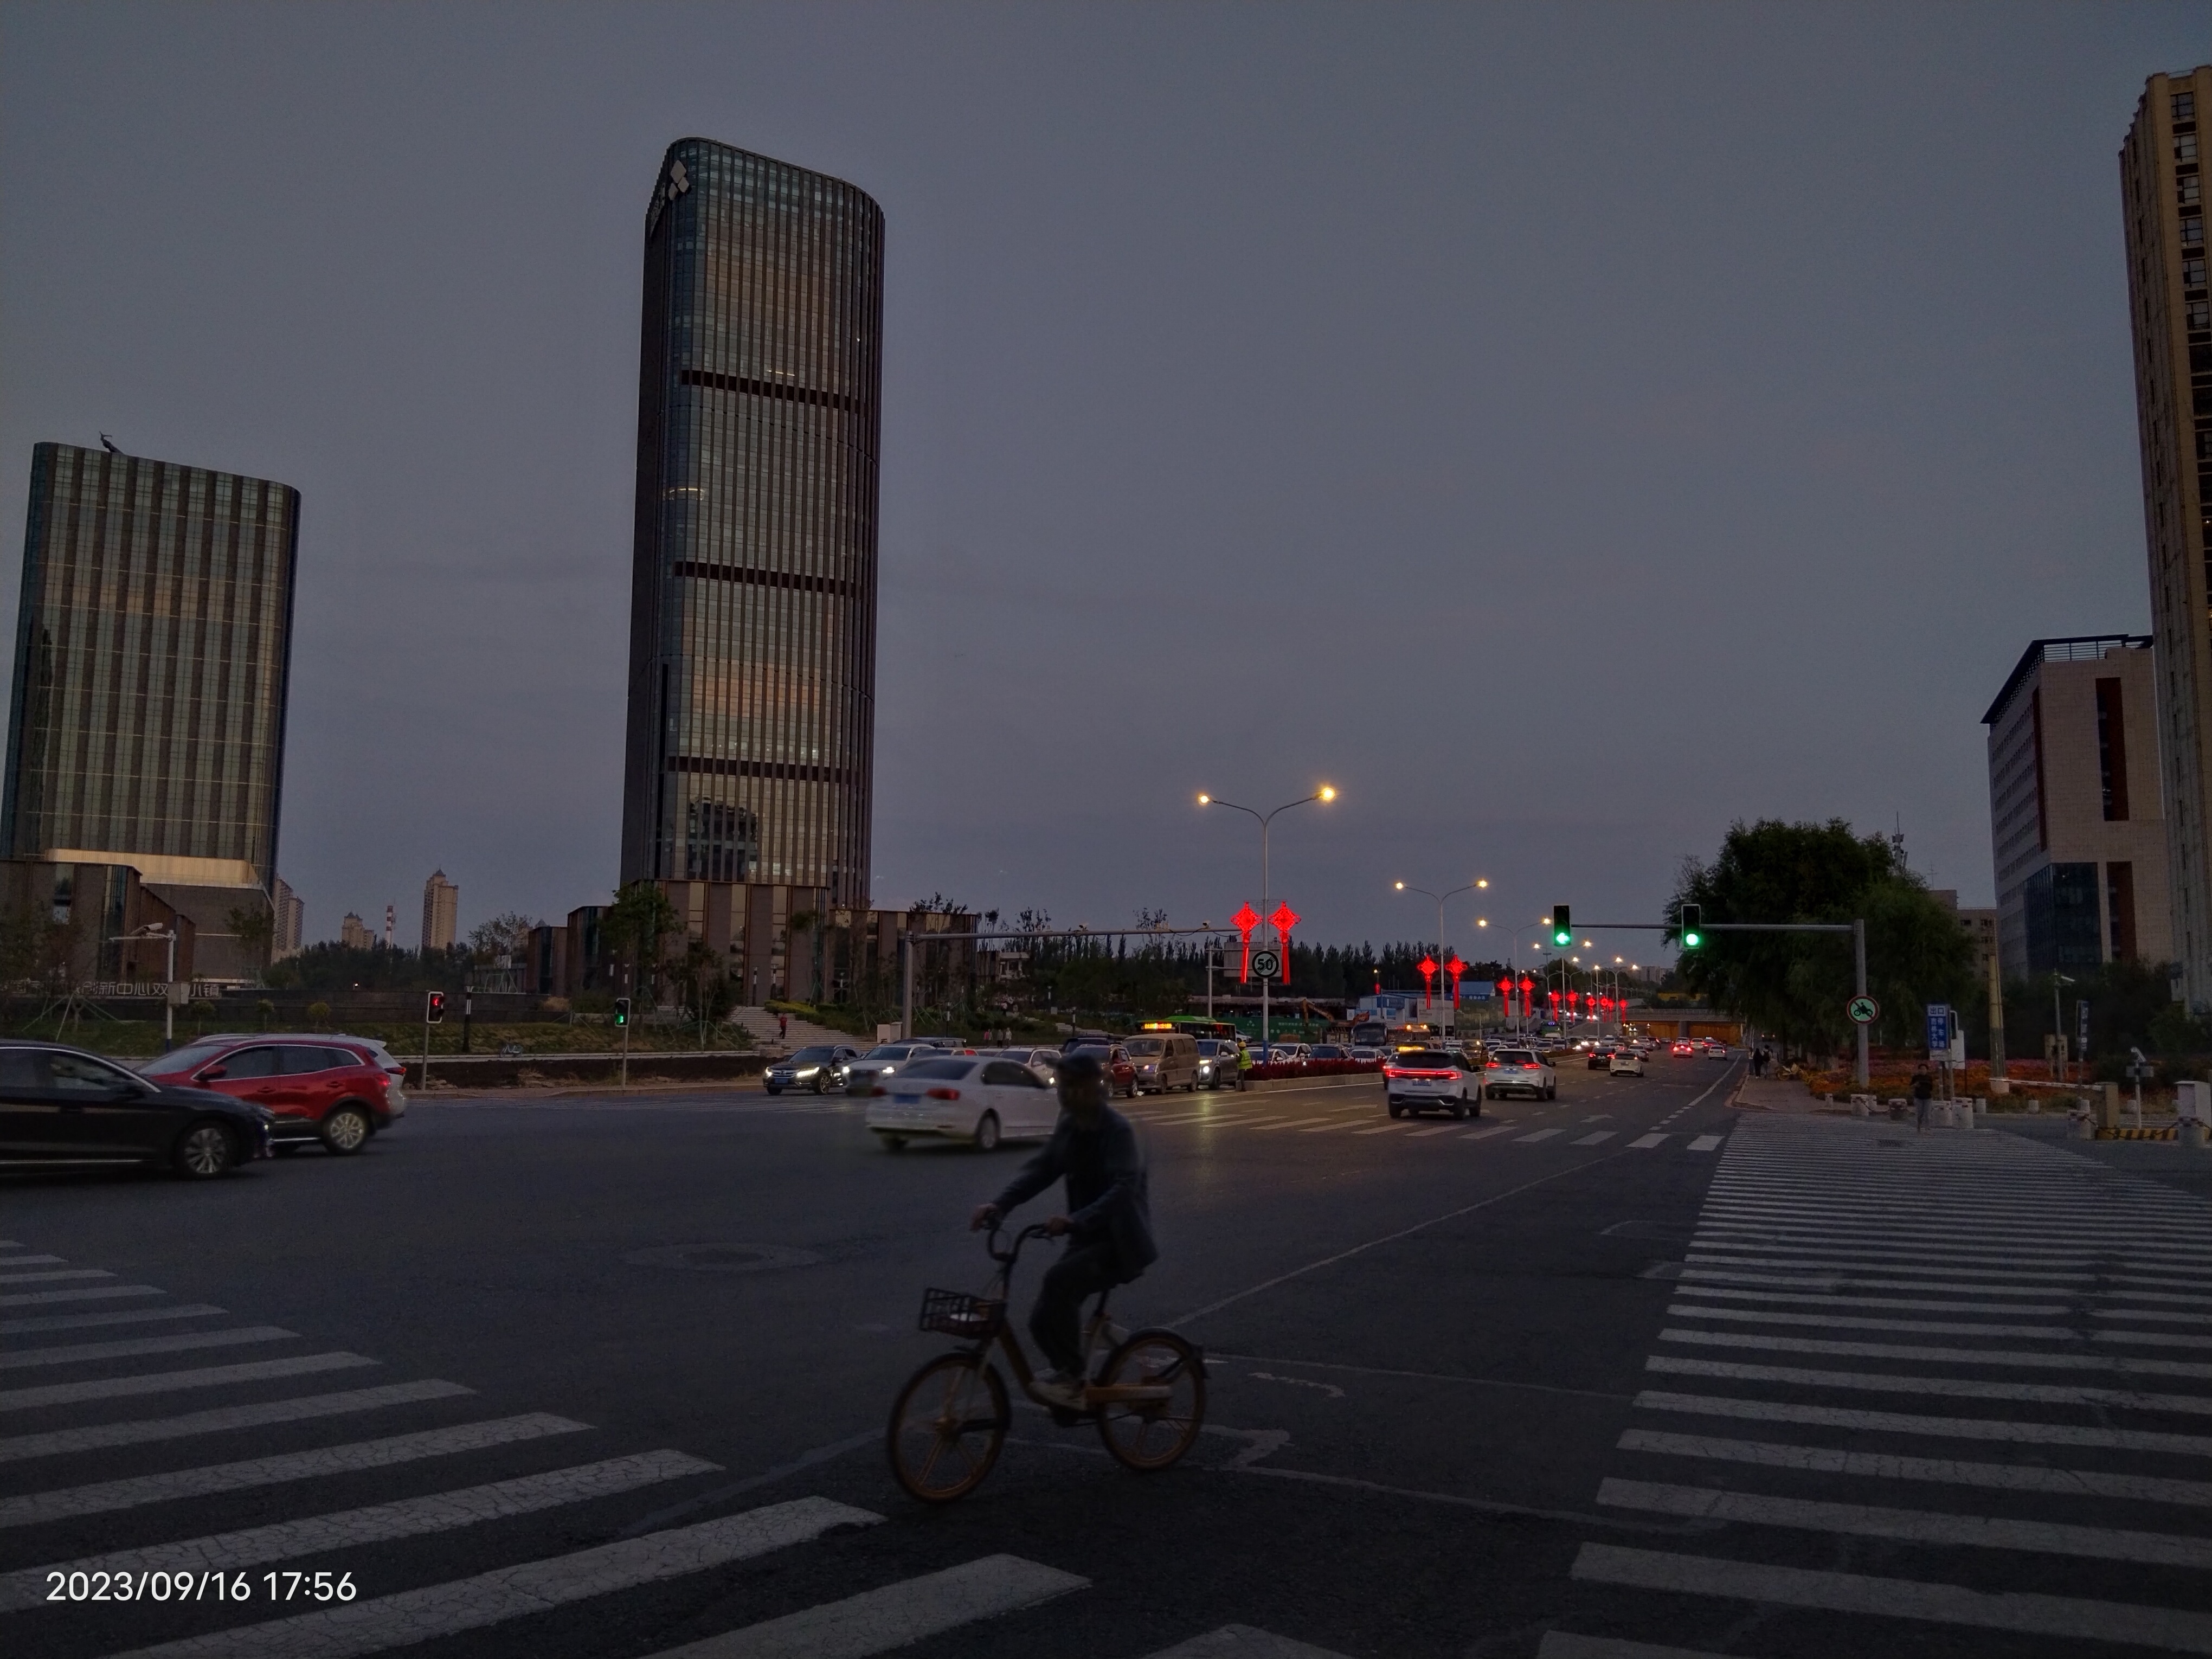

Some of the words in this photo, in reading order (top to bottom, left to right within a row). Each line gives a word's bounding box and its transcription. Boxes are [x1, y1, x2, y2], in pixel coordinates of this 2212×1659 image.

[1258, 959, 1272, 970] 50
[82, 981, 220, 997] 创新中心双小镇
